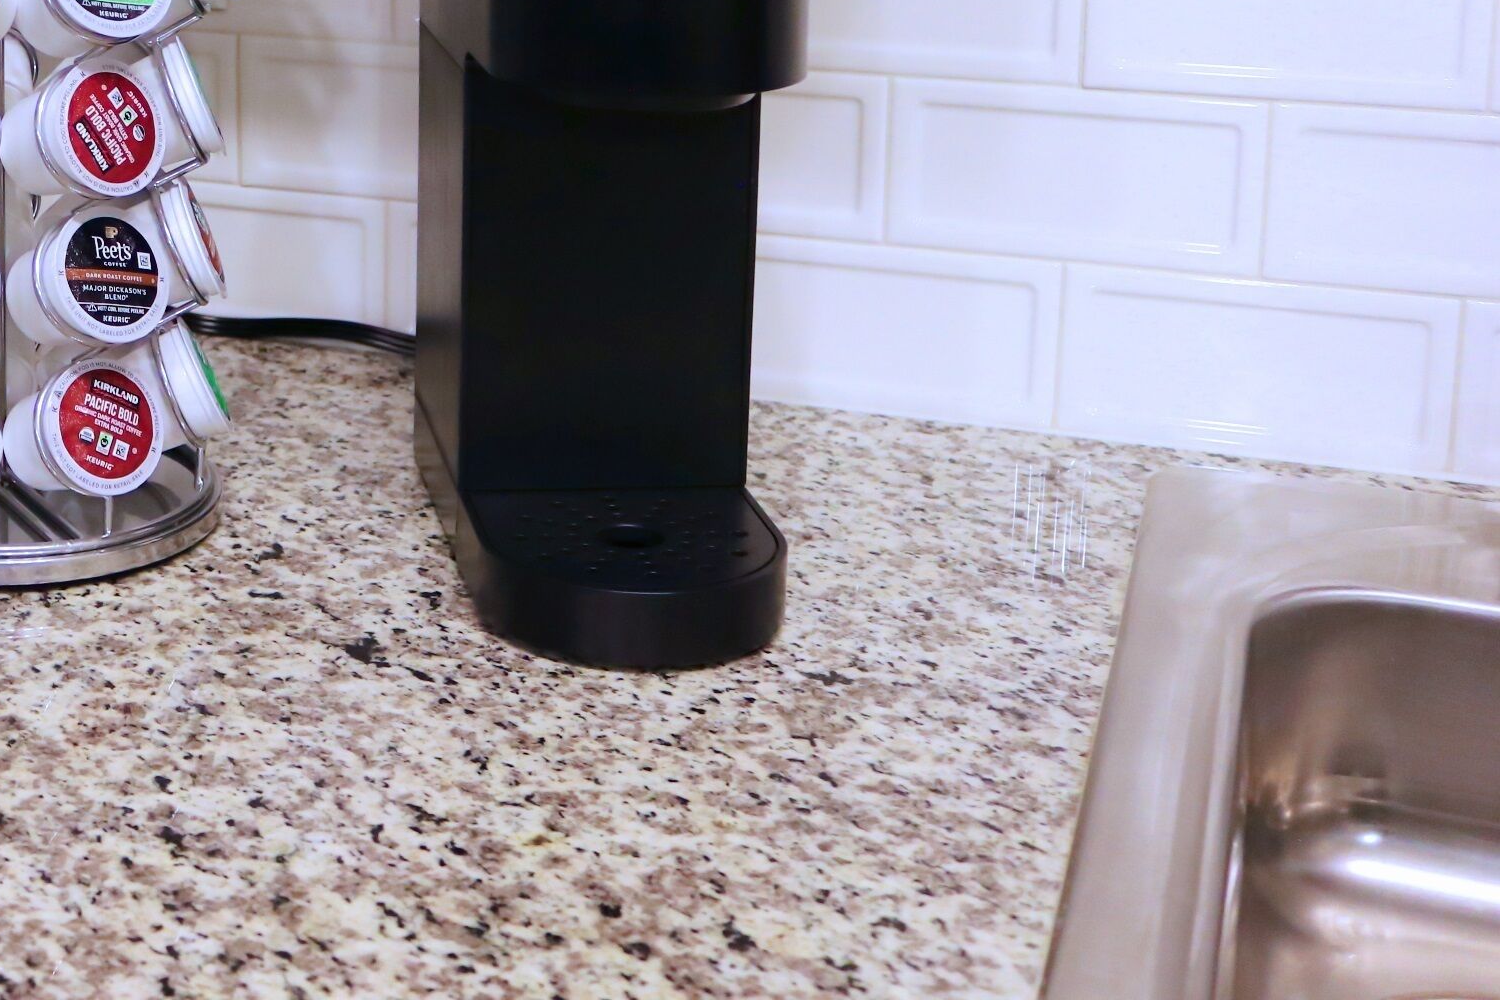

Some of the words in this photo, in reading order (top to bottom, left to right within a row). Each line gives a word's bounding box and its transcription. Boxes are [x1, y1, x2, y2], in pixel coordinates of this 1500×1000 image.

[99, 9, 127, 18] KEURIG
[128, 90, 148, 119] KEURIG
[84, 104, 107, 132] BOLD
[73, 120, 110, 173] KIRKLAND
[99, 128, 128, 166] PACIFIC
[91, 235, 132, 261] Peet's
[83, 284, 107, 292] MAJOR
[108, 286, 147, 296] DICKASON'S
[102, 315, 129, 323] KEURIG
[93, 379, 139, 405] KIRKLAND
[84, 393, 118, 417] PACIFIC
[119, 408, 139, 426] BOLD
[94, 418, 110, 429] EXTRA
[110, 425, 124, 436] BOLD
[97, 412, 111, 423] DARK
[125, 423, 143, 438] COFFEE
[85, 454, 112, 471] KEURIG
